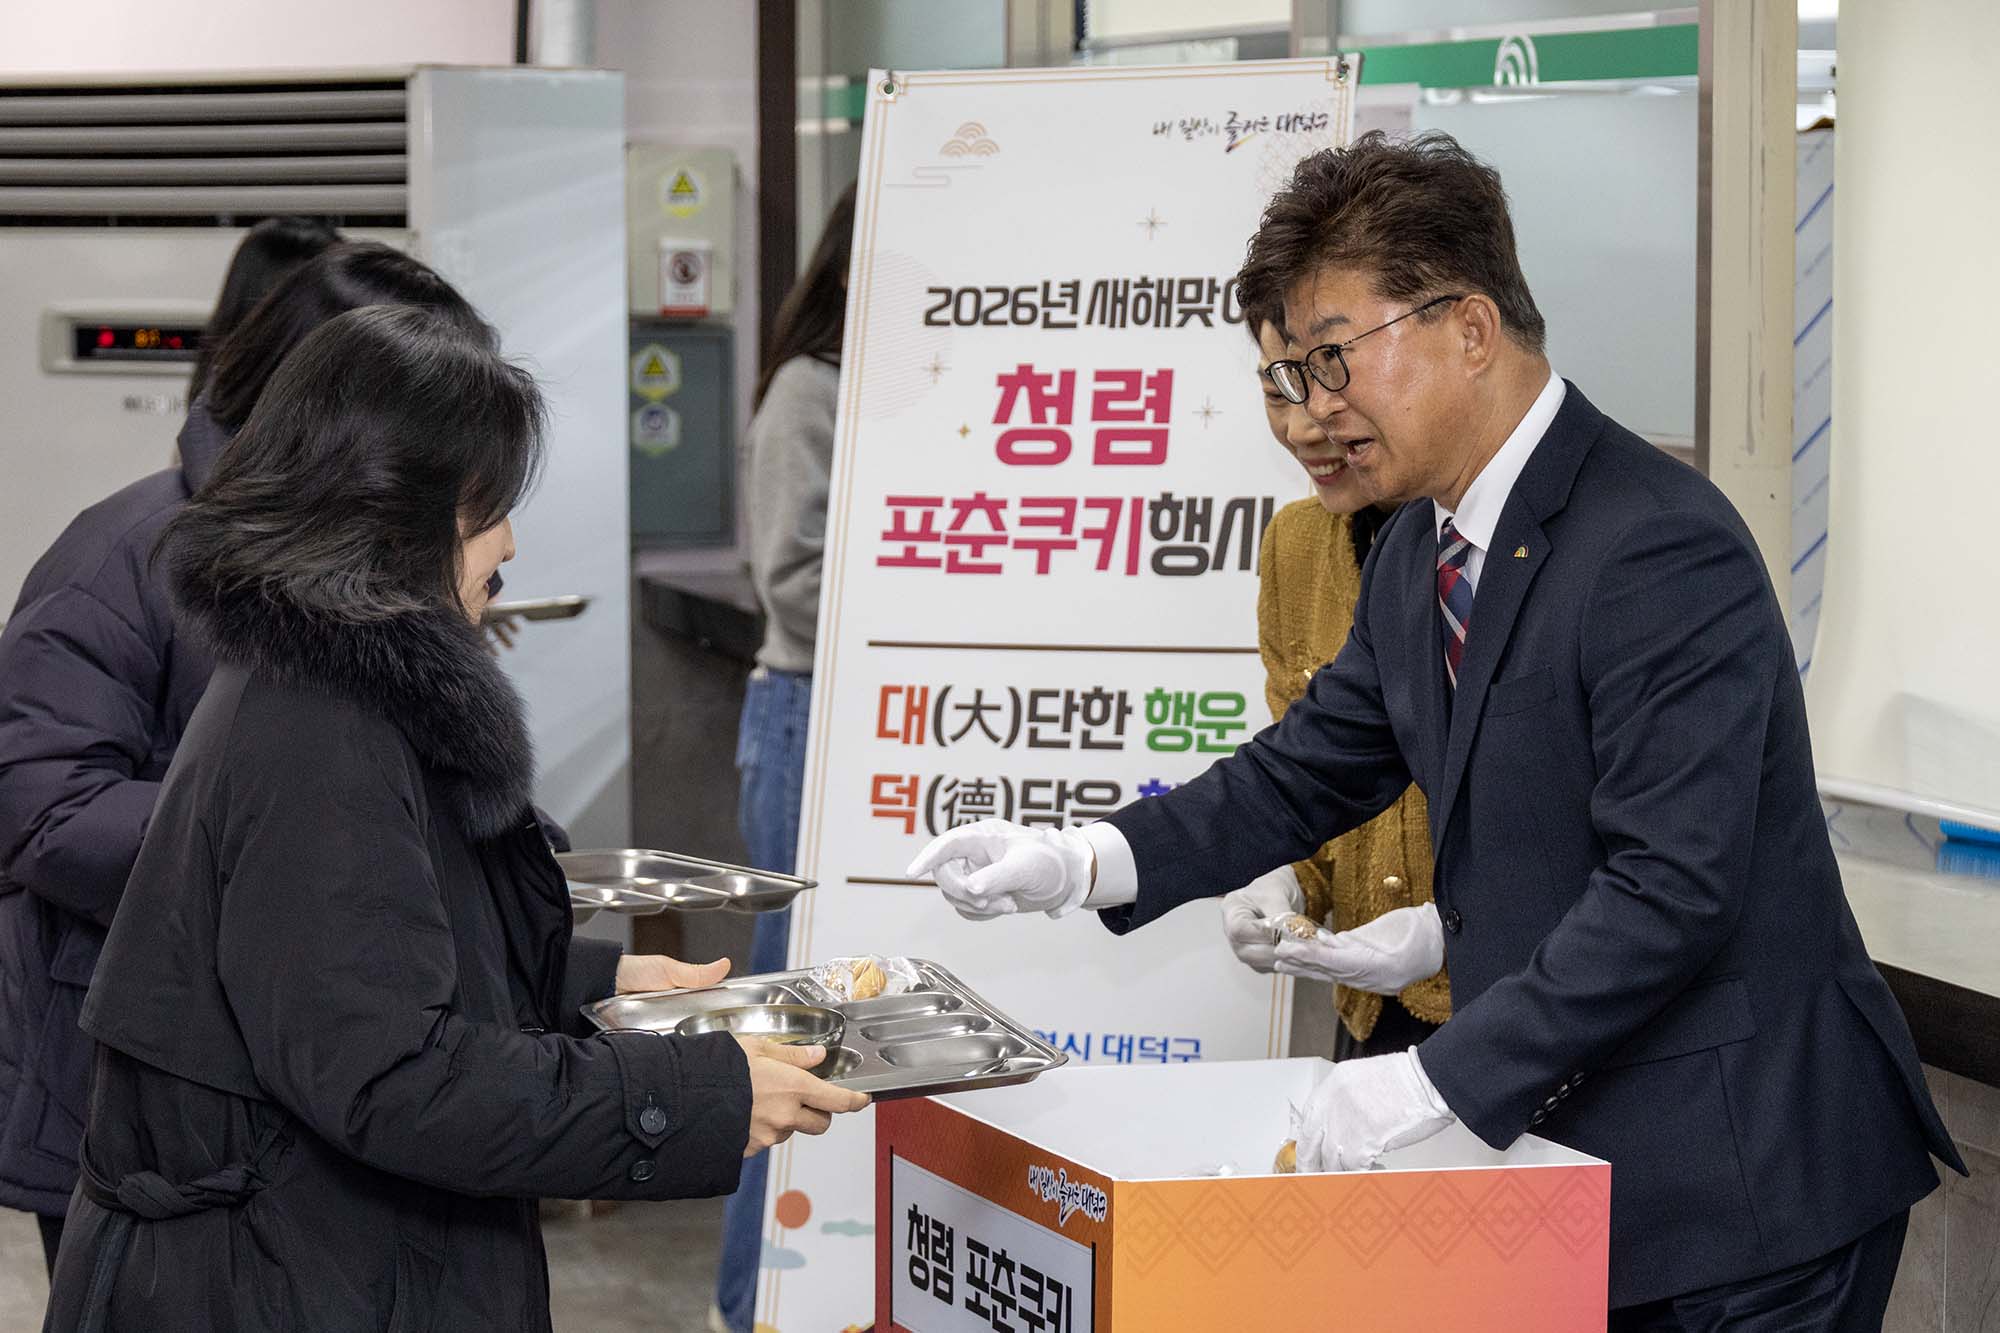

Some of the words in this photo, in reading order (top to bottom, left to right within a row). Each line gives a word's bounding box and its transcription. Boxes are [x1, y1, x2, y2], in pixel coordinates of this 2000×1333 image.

[1276, 112, 1329, 134] 대덕구
[993, 363, 1176, 467] 청렴
[876, 684, 1134, 752] 대(大)단한
[1144, 687, 1248, 753] 행운
[1102, 1033, 1203, 1064] 대덕구
[1080, 1185, 1107, 1221] 대덕구
[907, 1202, 955, 1307] 청렴
[964, 1236, 1073, 1333] 포춘쿠키
